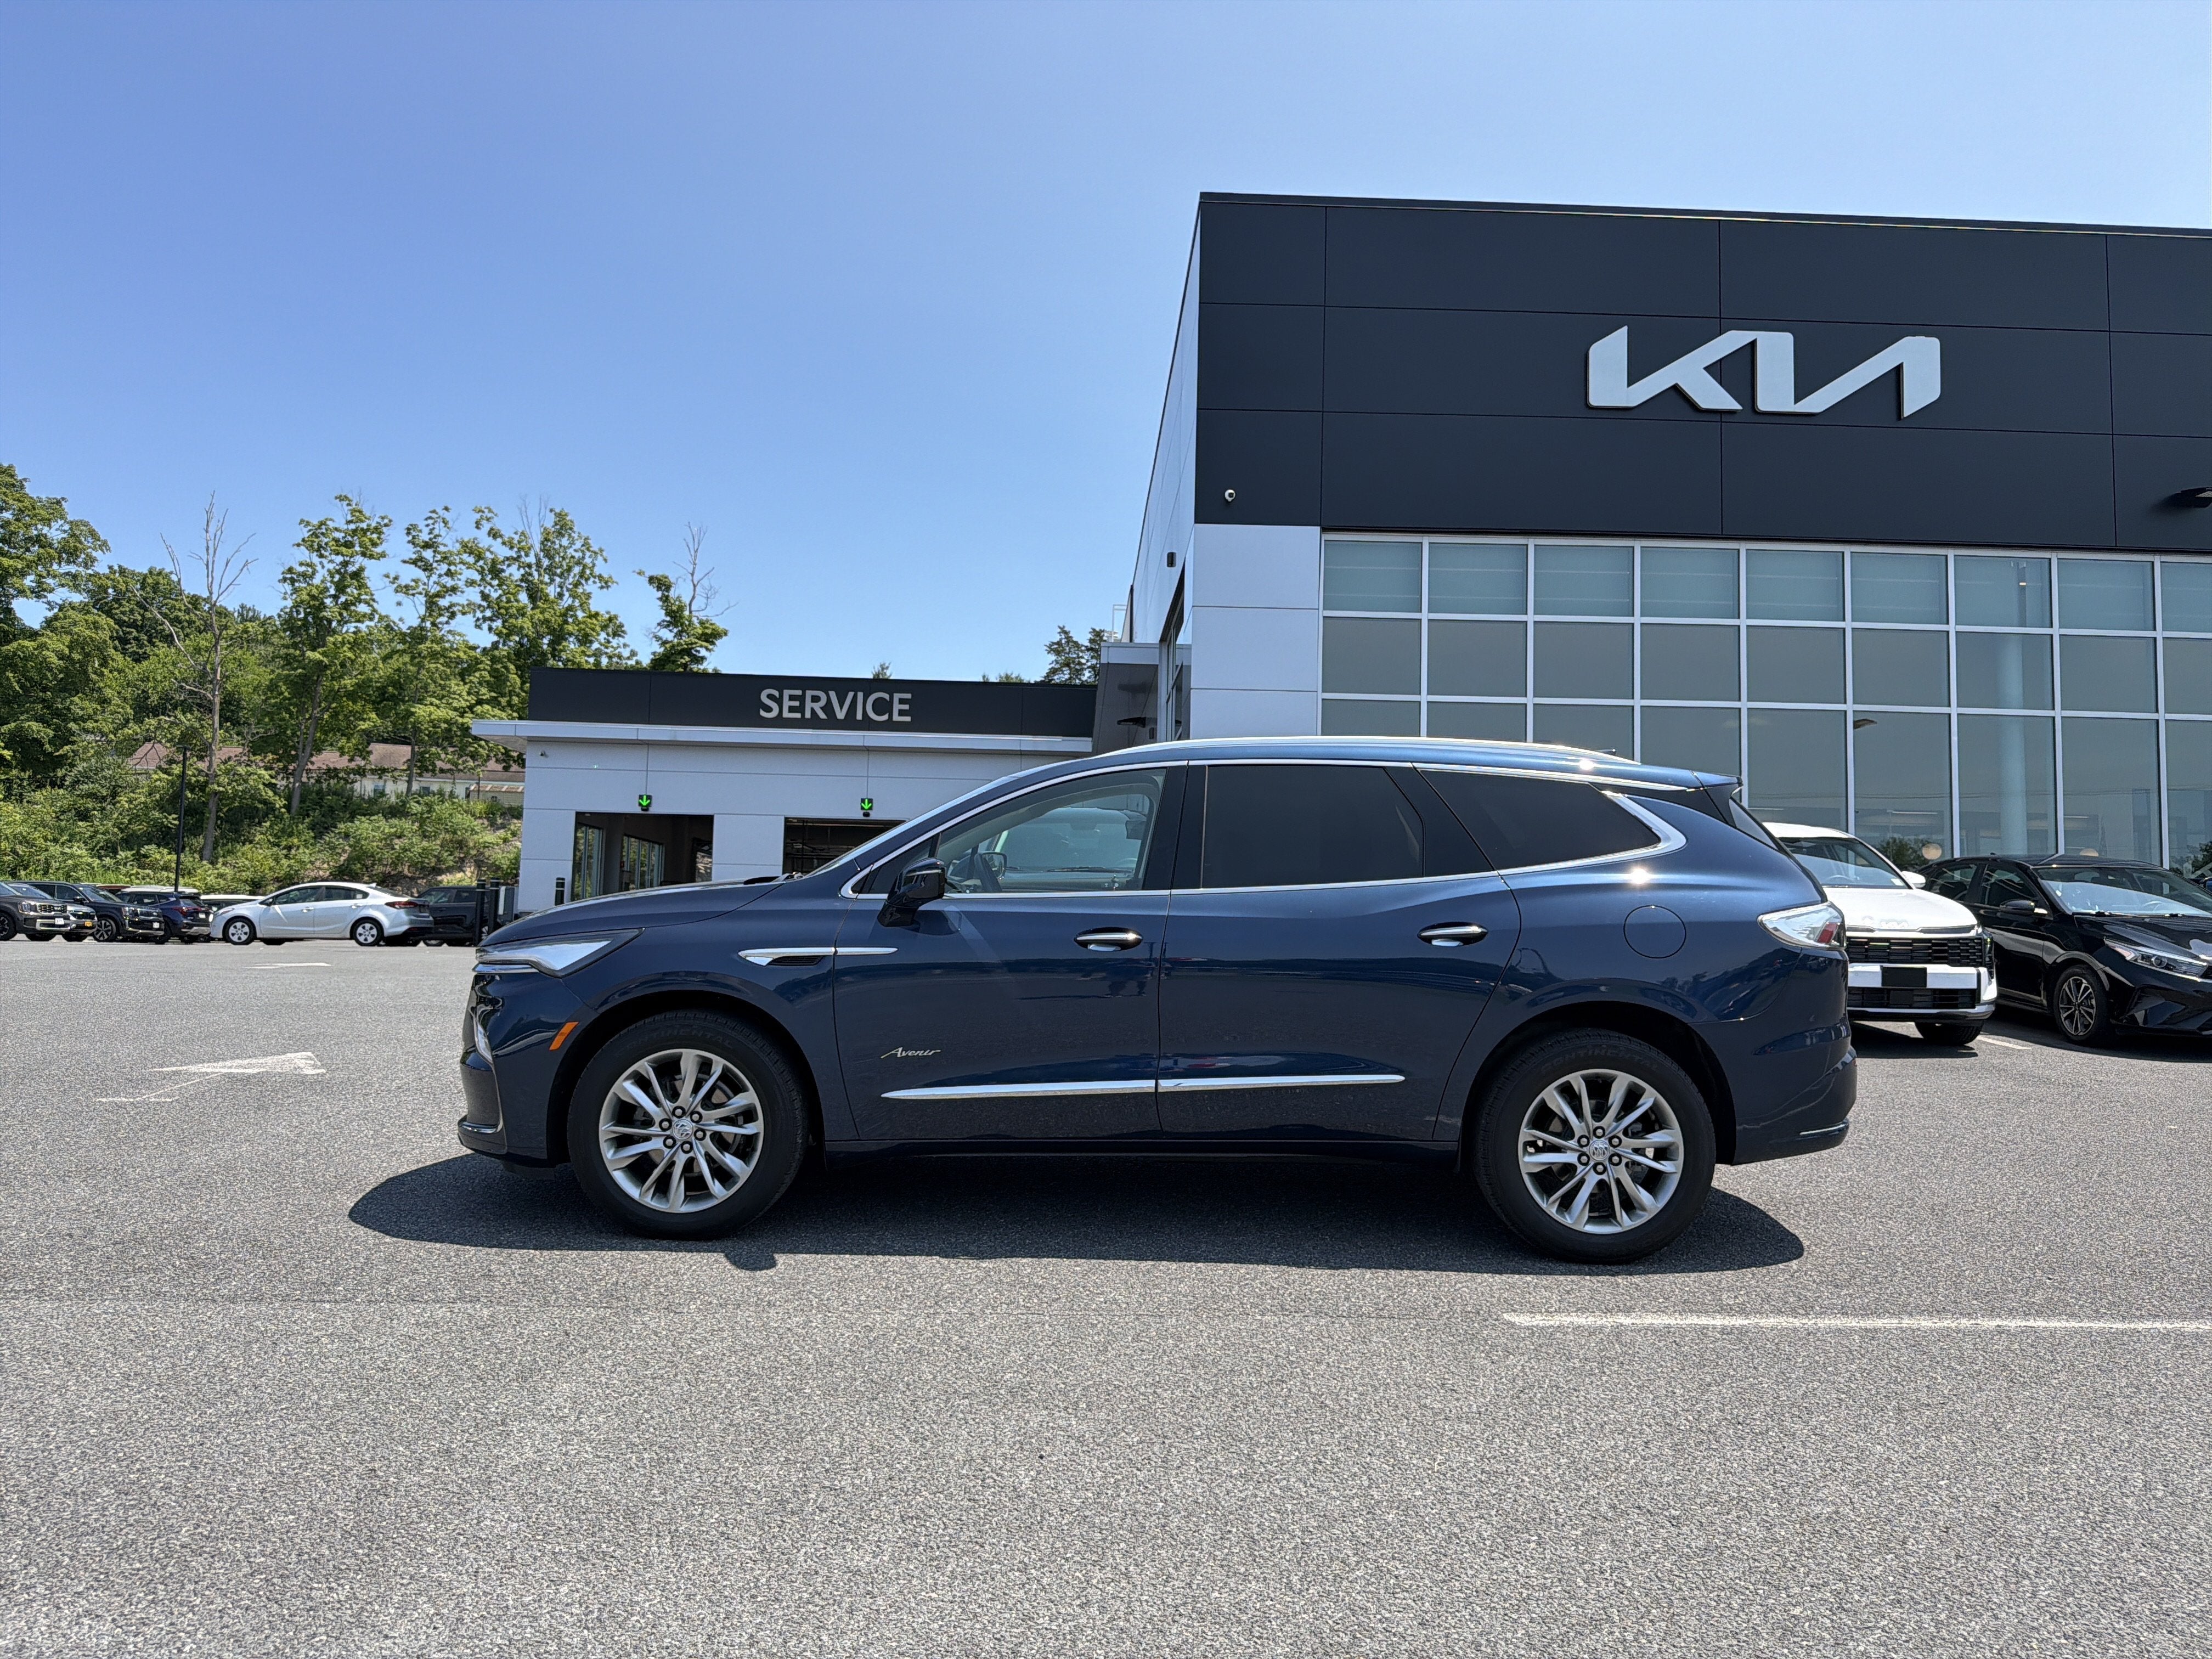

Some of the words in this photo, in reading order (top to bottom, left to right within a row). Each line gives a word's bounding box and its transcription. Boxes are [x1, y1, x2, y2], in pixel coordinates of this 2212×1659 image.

[1588, 325, 1941, 419] KIA
[759, 689, 912, 722] SERVICE
[880, 1047, 941, 1059] Avenir
